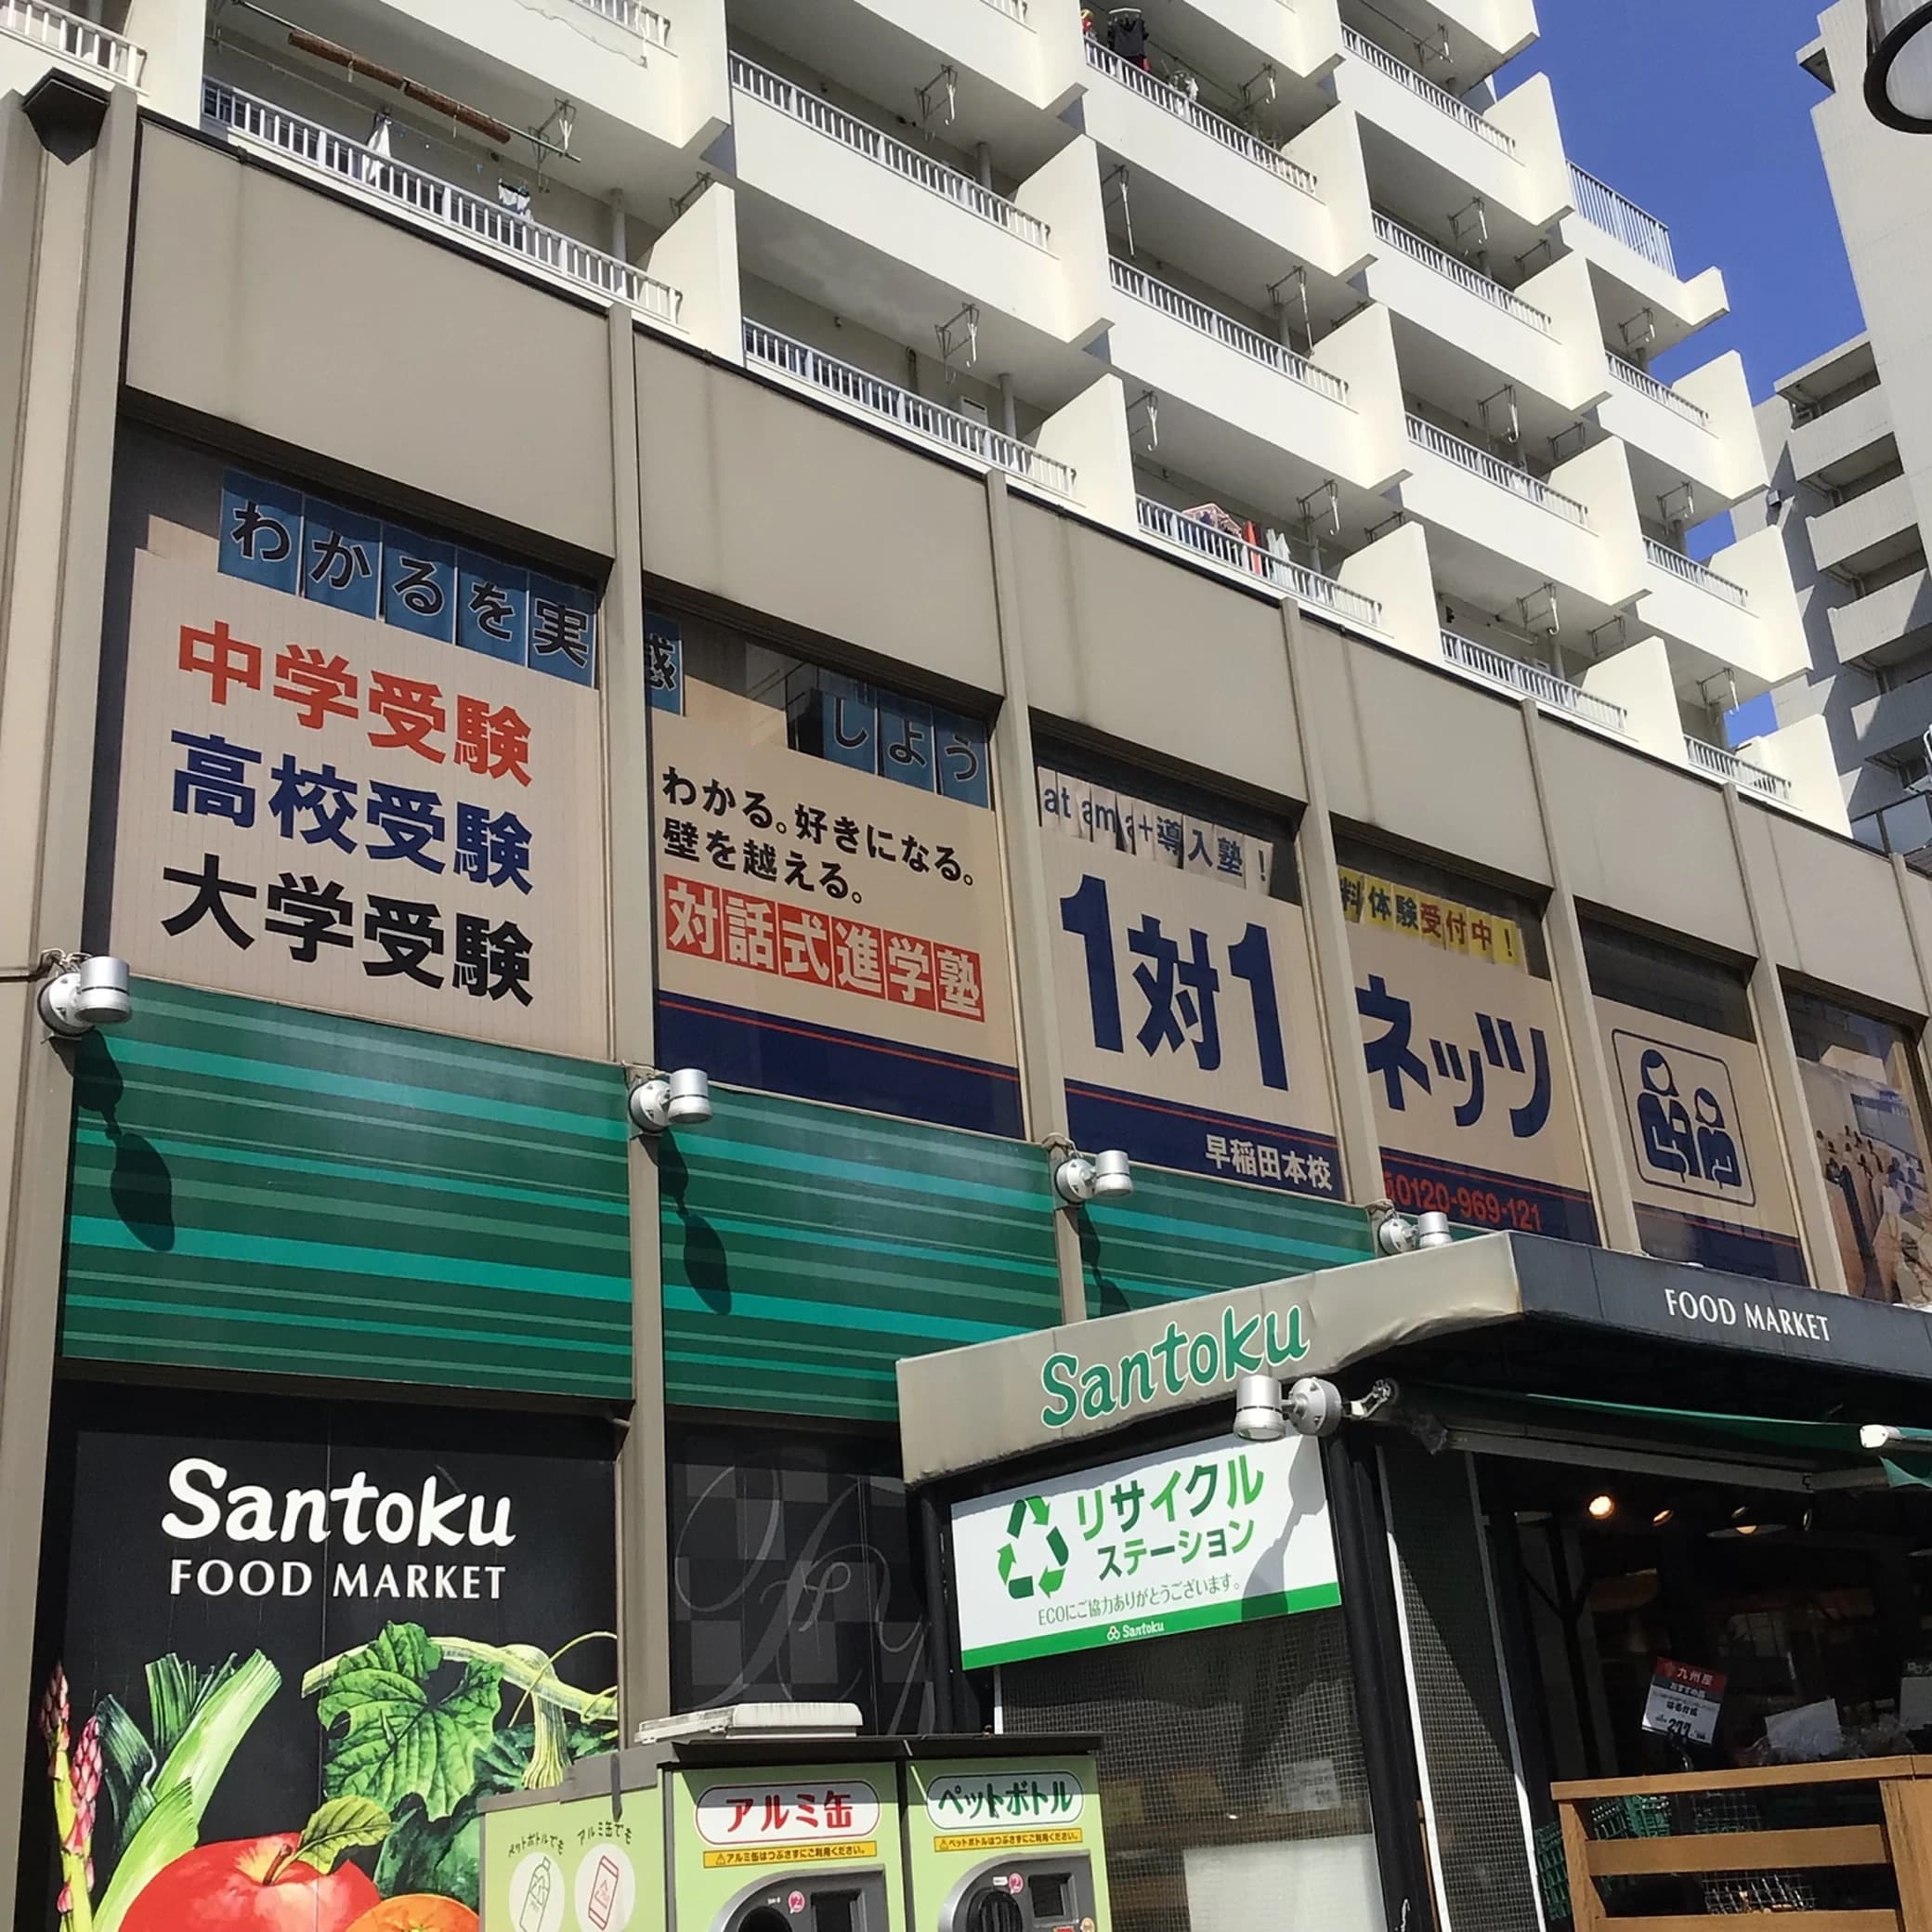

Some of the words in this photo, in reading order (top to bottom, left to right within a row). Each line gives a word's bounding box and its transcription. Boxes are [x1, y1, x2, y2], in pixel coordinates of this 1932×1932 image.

[231, 502, 591, 669] わかるを実
[177, 620, 532, 787] 中学受験
[834, 698, 979, 781] しよう
[171, 729, 533, 894] 高校受験
[662, 766, 973, 886] わかる。好きになる。
[663, 817, 862, 904] 壁を越える。
[161, 853, 534, 1007] 大学受験
[667, 881, 982, 1019] 対話式進学塾
[1060, 873, 1289, 1092] 1対1
[1354, 973, 1552, 1139] ネッツ
[1206, 1134, 1333, 1192] 早稲田本校
[1664, 1288, 1737, 1326] FOOD
[1743, 1302, 1831, 1342] MARKET
[1040, 1304, 1311, 1428] Santoku
[161, 1457, 516, 1547] Santoku
[1077, 1454, 1264, 1541] リサイクル
[170, 1558, 313, 1598] FOOD
[333, 1562, 506, 1599] MARKET
[1097, 1519, 1256, 1581] ステーション
[1038, 1572, 1241, 1626] ECOにご協力ありがとうございます。
[1122, 1621, 1165, 1638] Santoku
[725, 1789, 854, 1833] アルミ缶
[937, 1780, 1074, 1820] ペットボトル
